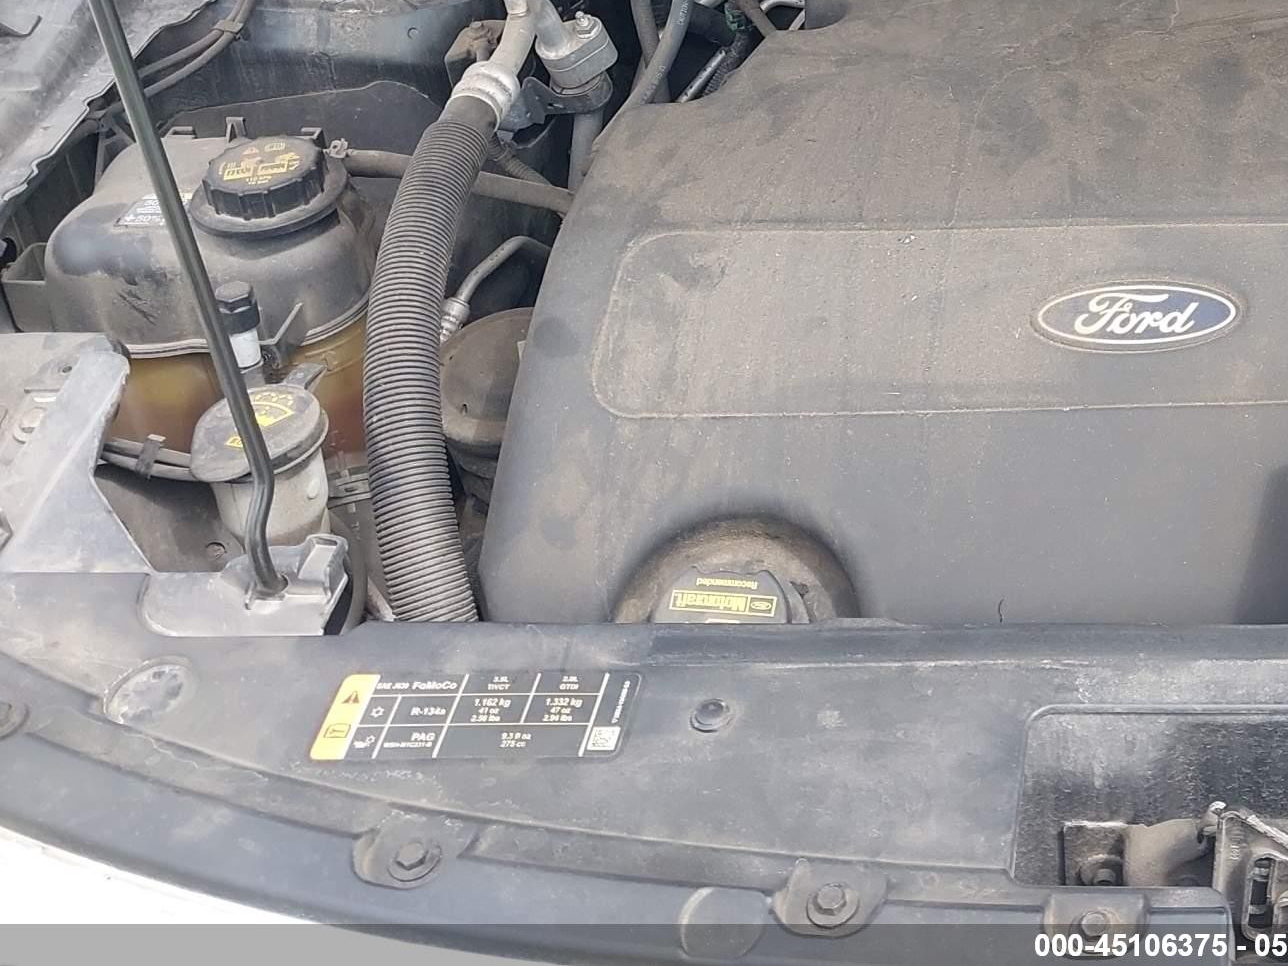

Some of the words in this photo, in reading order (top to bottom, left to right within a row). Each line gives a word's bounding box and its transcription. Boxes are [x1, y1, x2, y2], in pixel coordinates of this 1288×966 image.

[1074, 292, 1199, 334] Ford
[697, 578, 757, 589] Recommended
[676, 593, 746, 611] Motorcraft
[411, 680, 458, 690] FoMoCo
[474, 698, 497, 707] 1.162
[498, 698, 512, 708] kg
[545, 698, 569, 707] 1.332
[569, 698, 583, 708] kg
[410, 732, 436, 742] PAG
